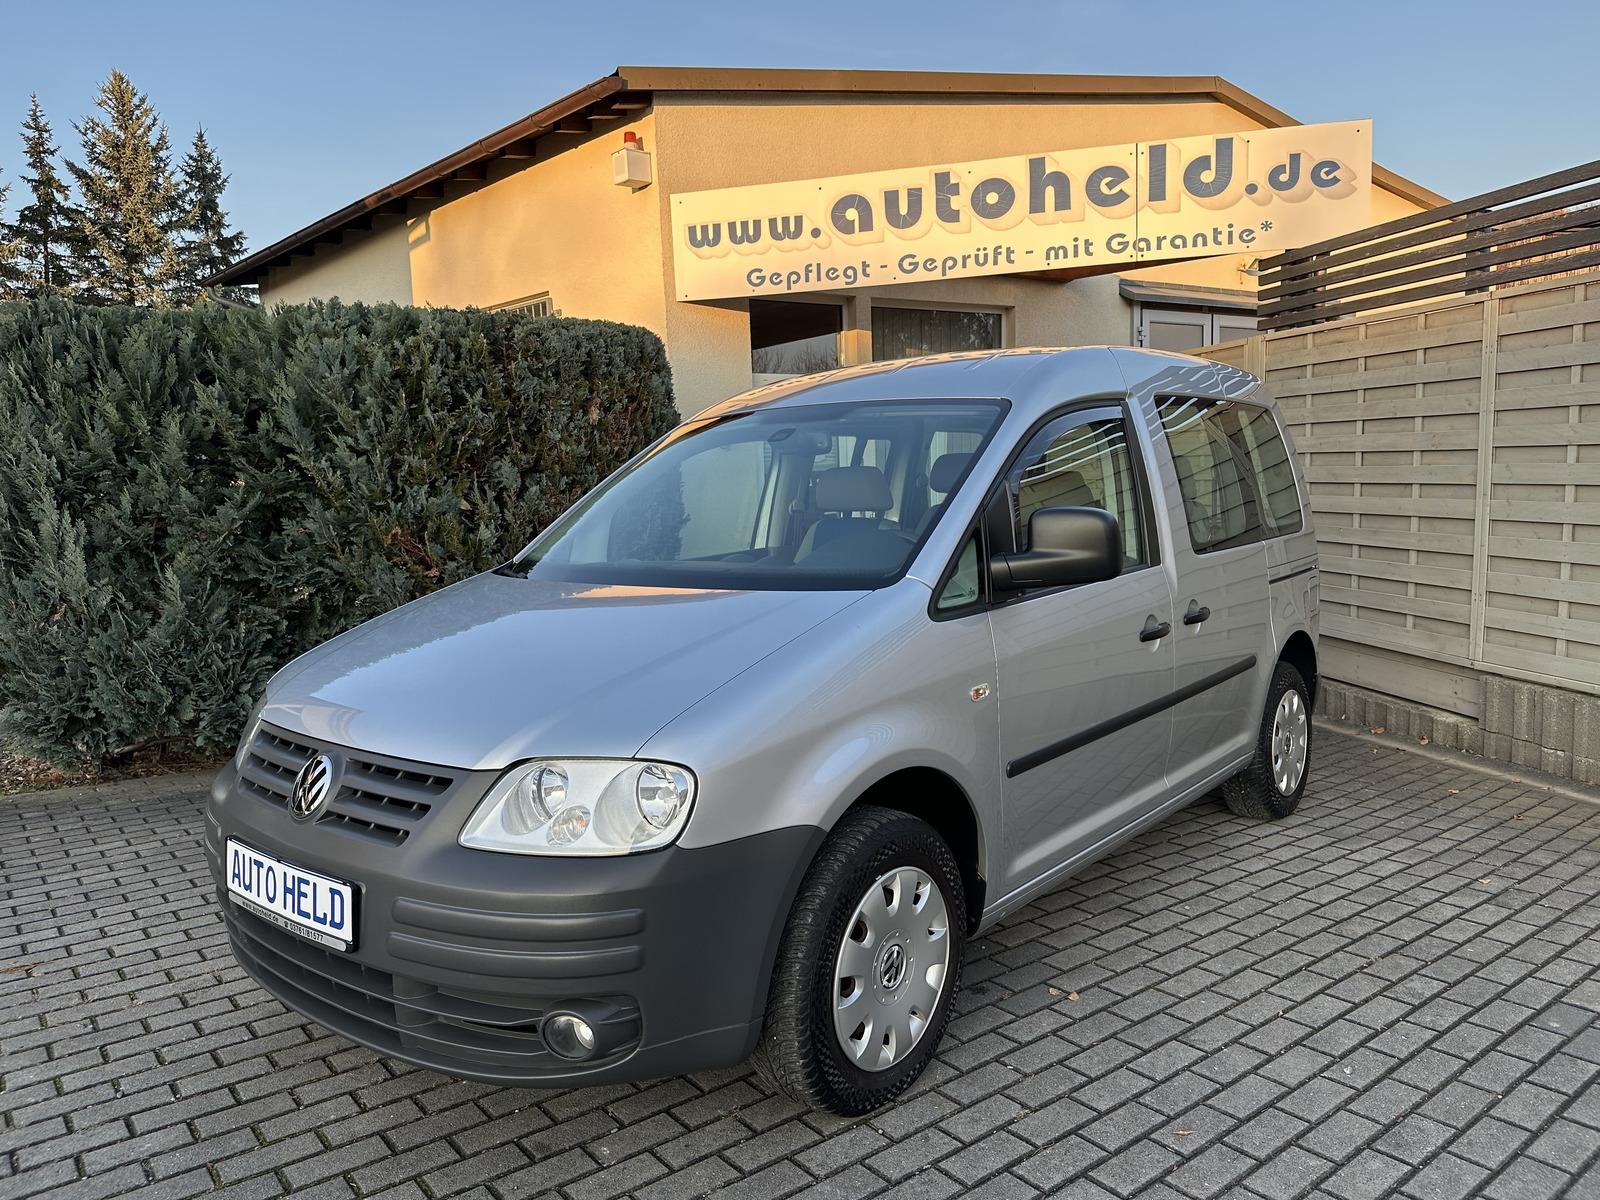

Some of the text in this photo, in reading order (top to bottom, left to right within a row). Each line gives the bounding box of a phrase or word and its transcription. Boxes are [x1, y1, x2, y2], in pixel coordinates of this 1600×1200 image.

[688, 137, 1342, 249] www.autoheld.de
[746, 260, 871, 291] Gepflegt
[898, 245, 1015, 277] Geprüft
[1045, 237, 1094, 261] mit
[231, 849, 345, 930] AUTO HELD
[242, 900, 279, 923] www.autoheld.de
